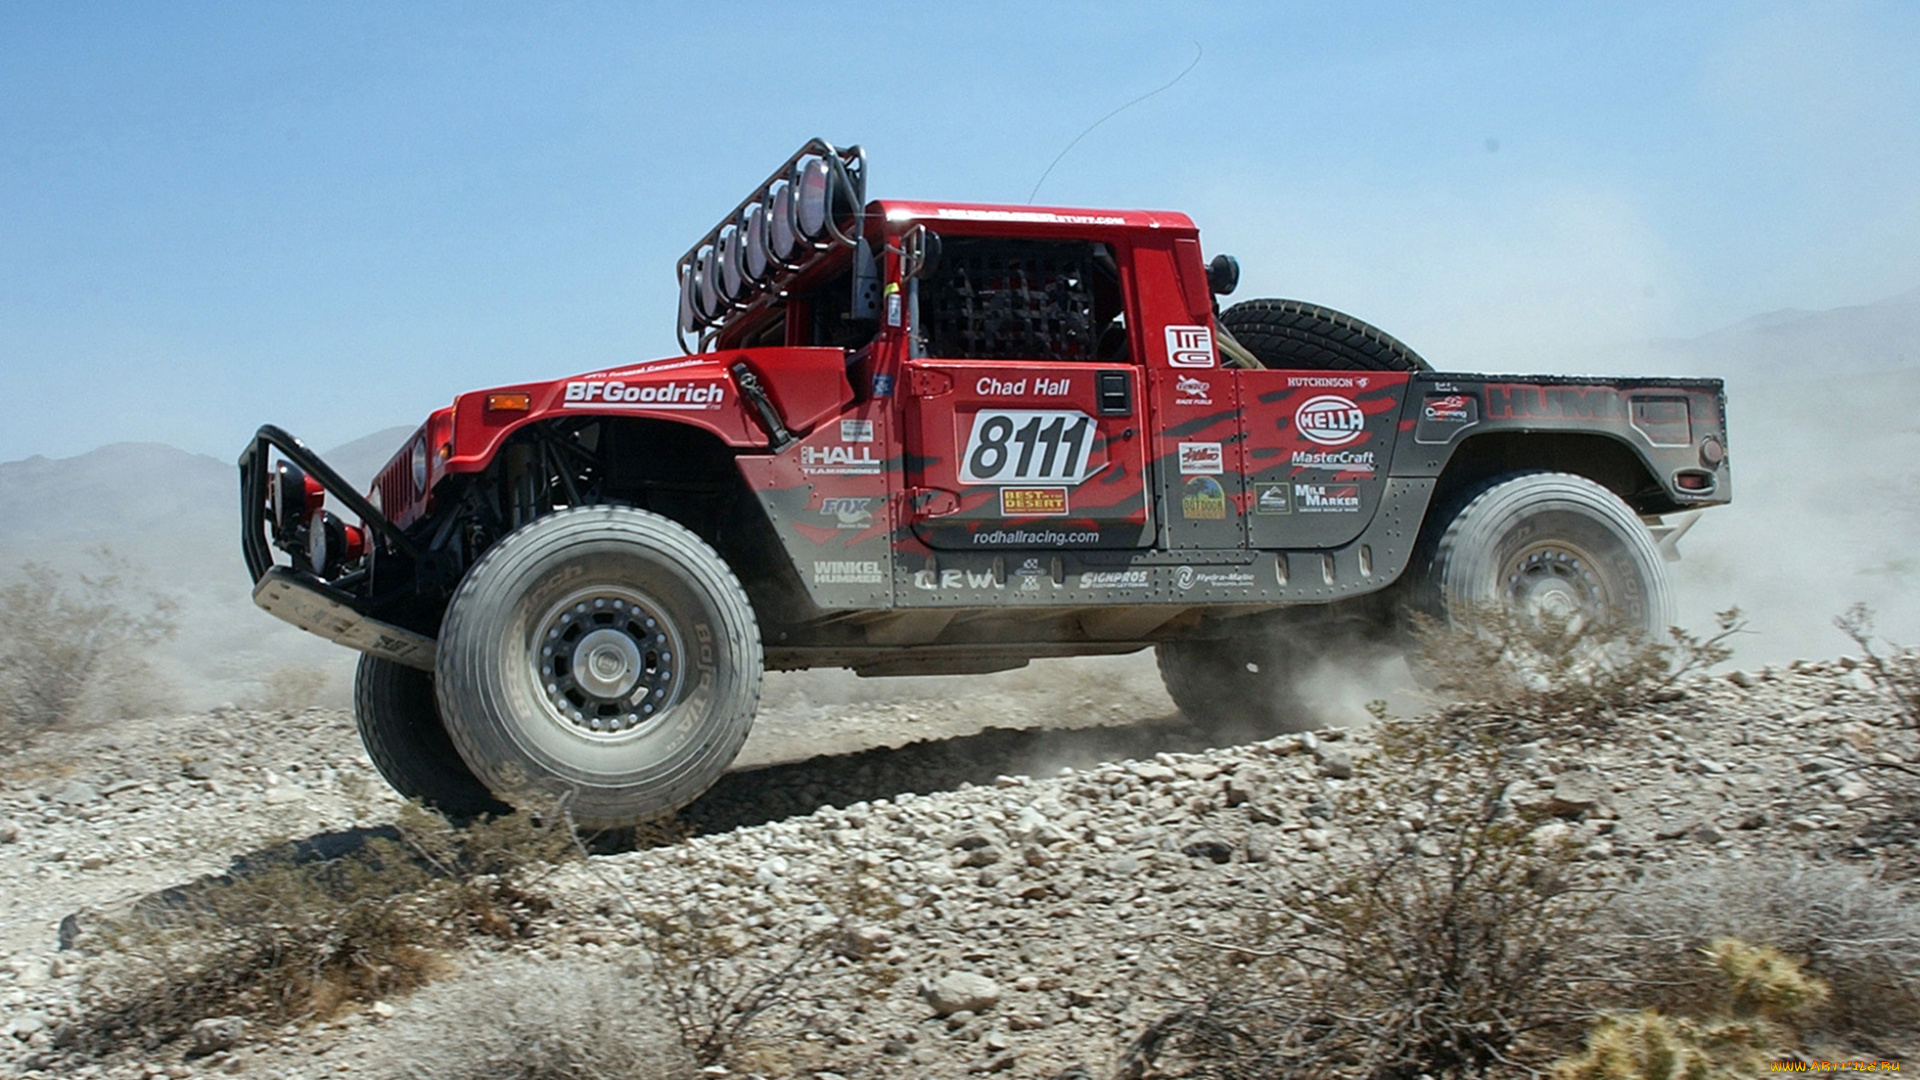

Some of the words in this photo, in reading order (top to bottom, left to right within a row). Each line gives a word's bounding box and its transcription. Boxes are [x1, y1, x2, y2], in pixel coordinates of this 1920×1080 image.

[976, 377, 1026, 395] Chad
[1033, 378, 1070, 395] Hall
[1287, 377, 1353, 387] HUTCHINSON
[564, 381, 724, 402] BFGoodrich
[1300, 409, 1364, 430] HELLA
[808, 446, 881, 464] HALL
[969, 415, 1089, 479] 8111
[1290, 451, 1374, 463] MasterCraft
[1005, 491, 1043, 499] BEST
[1005, 499, 1064, 507] DESERT
[820, 497, 872, 515] FOX
[973, 530, 1099, 546] rodhallracing.com
[813, 560, 882, 574] WINKEL
